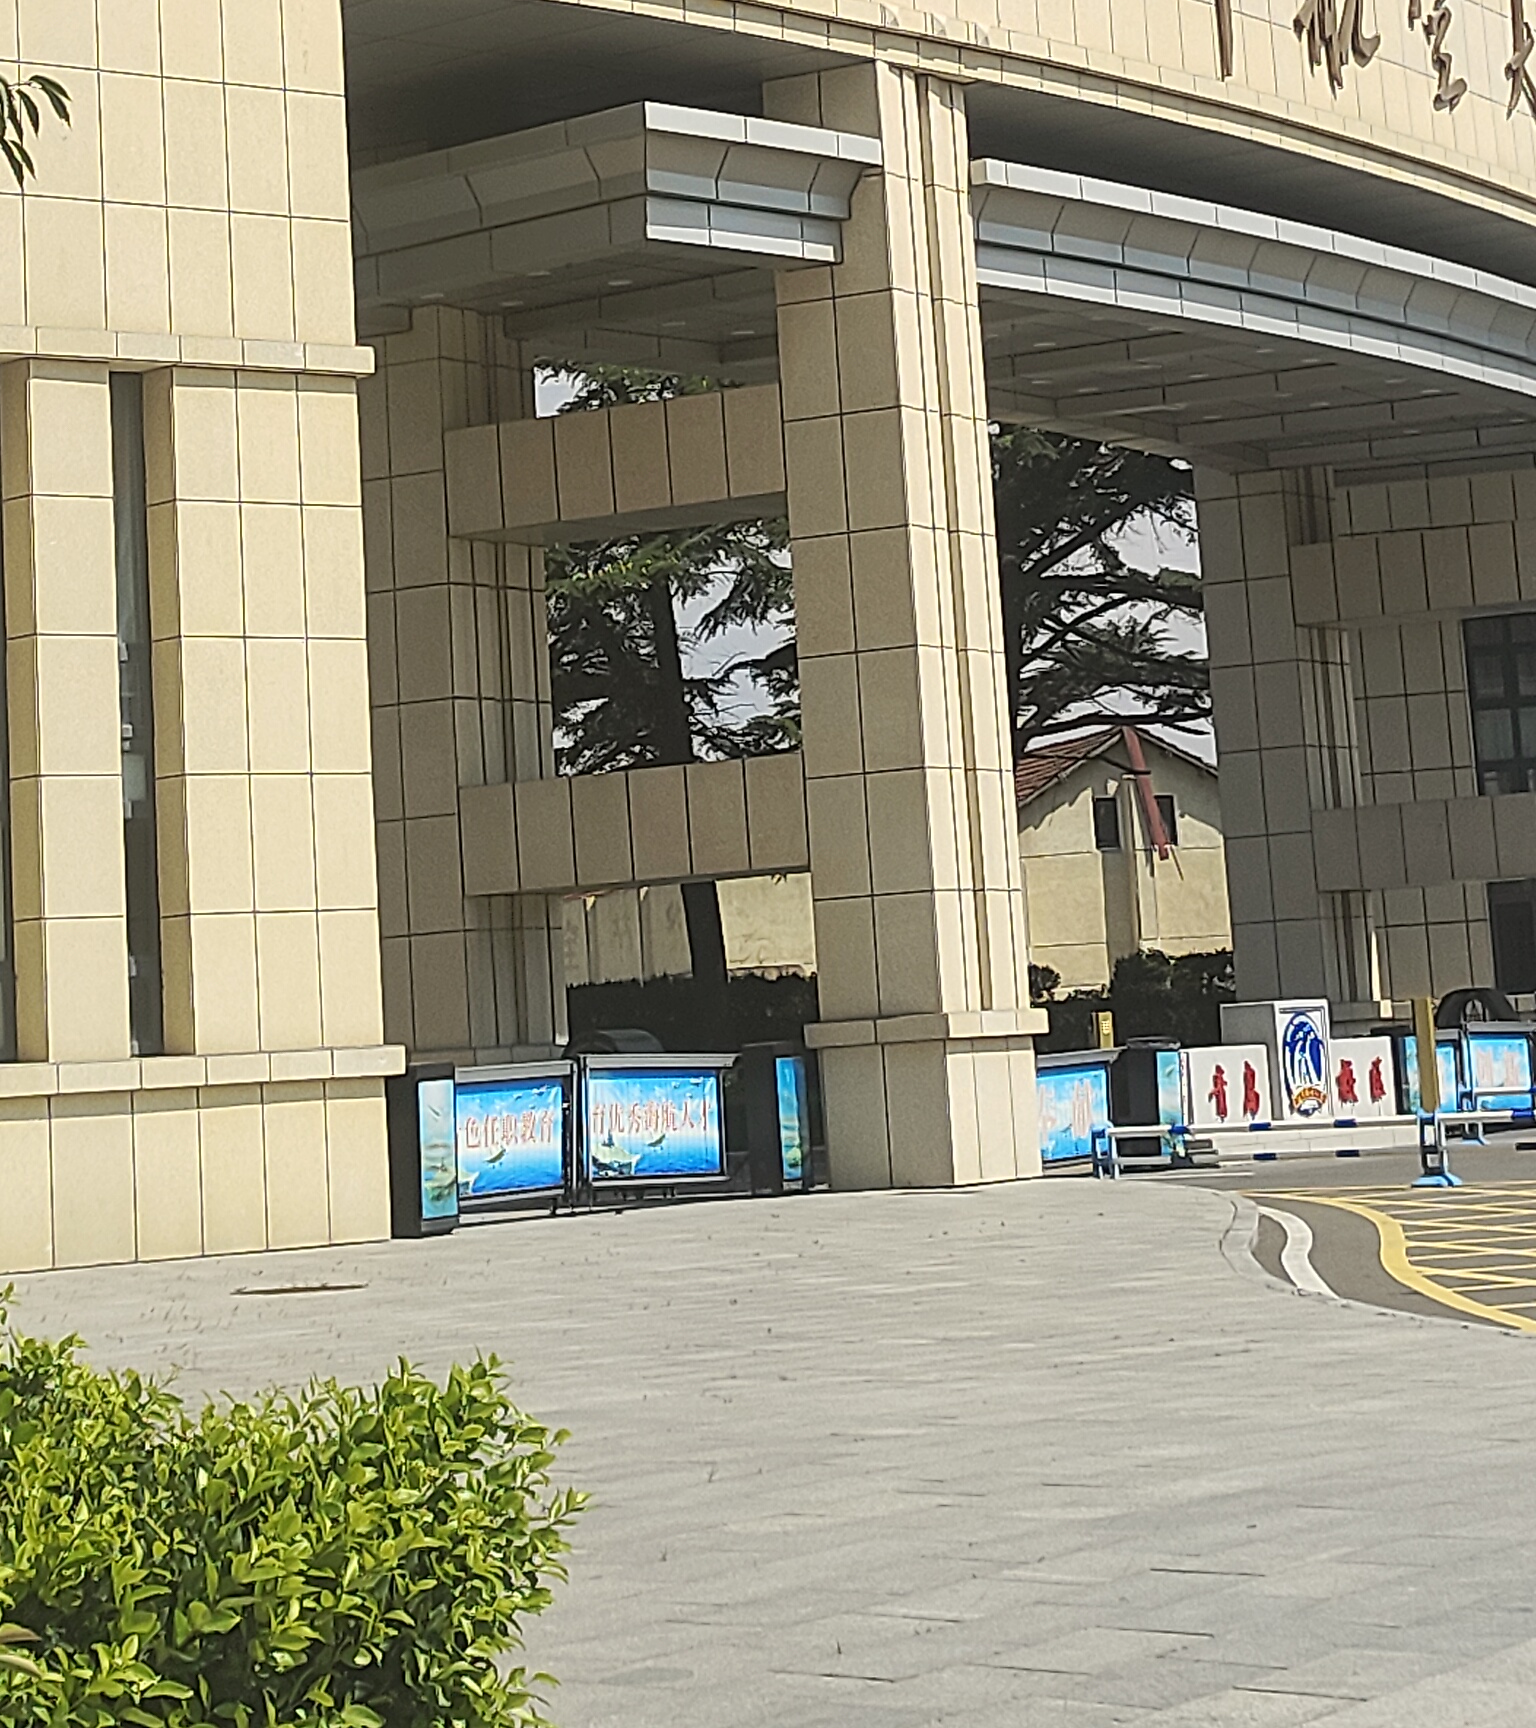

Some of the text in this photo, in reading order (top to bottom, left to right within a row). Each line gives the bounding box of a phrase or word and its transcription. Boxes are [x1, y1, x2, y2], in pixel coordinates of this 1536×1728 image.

[457, 1110, 556, 1149] 色任职教育
